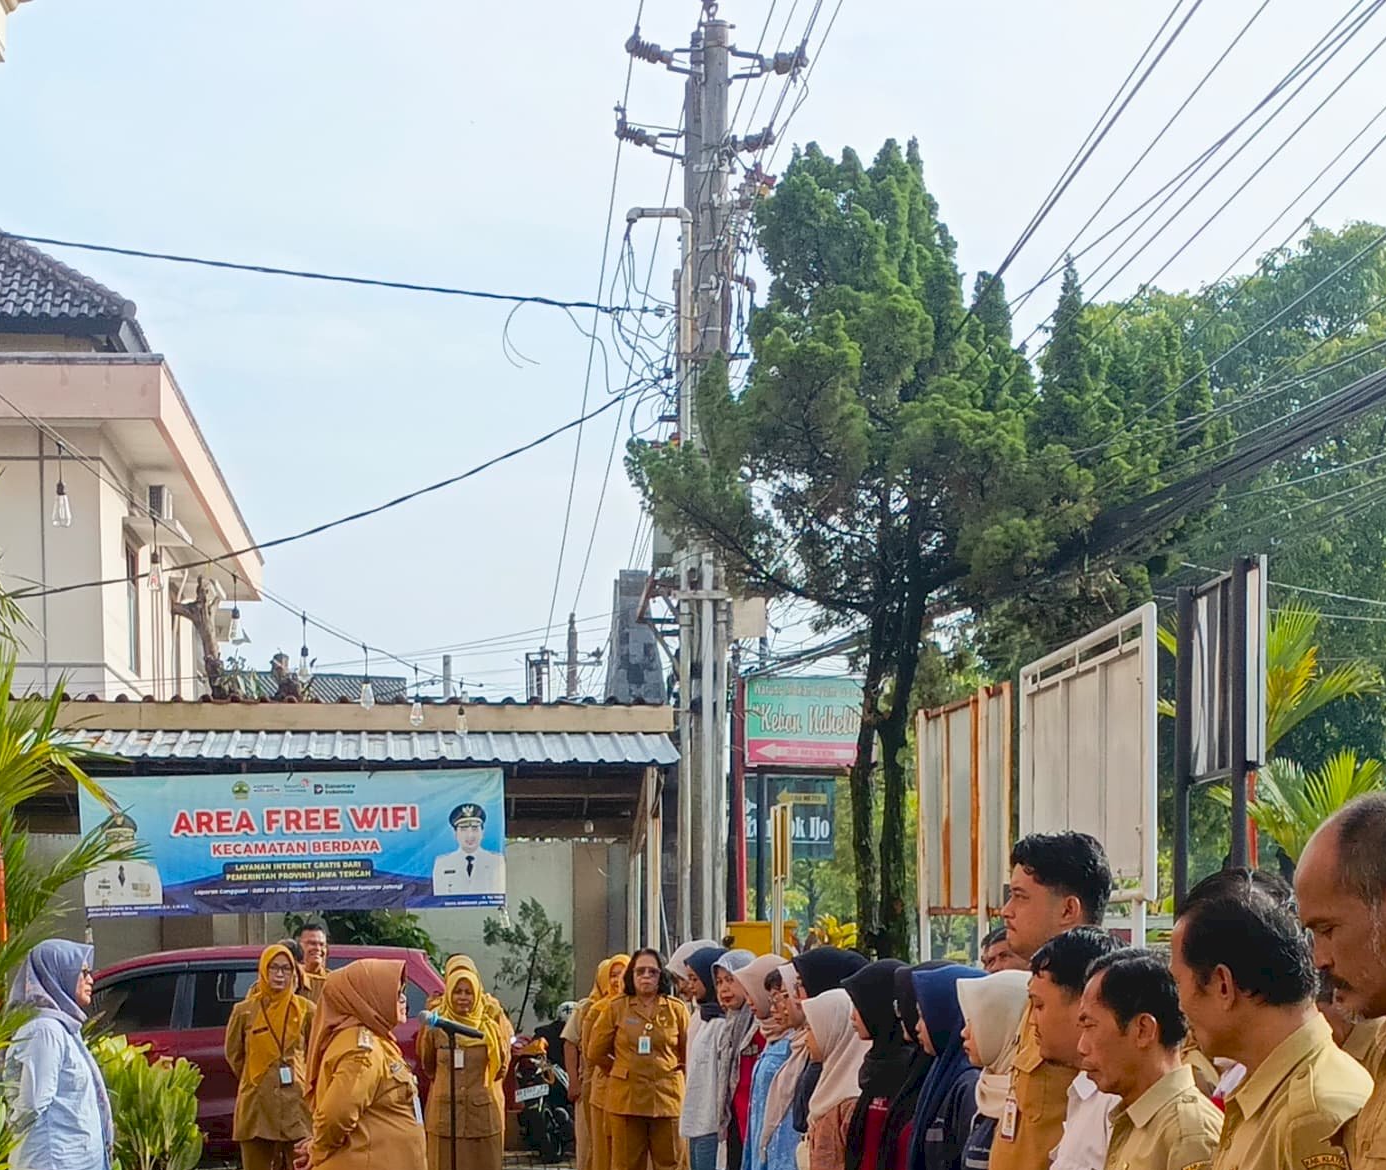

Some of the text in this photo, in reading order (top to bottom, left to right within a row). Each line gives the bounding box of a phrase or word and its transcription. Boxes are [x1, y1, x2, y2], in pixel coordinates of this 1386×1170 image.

[172, 806, 418, 835] AREA FREE WIFI
[212, 840, 380, 856] KECAMATAN BERDAYA
[342, 861, 362, 869] DARI
[226, 869, 371, 881] PEMERINTAH PROVINSI JAWA TENGAH
